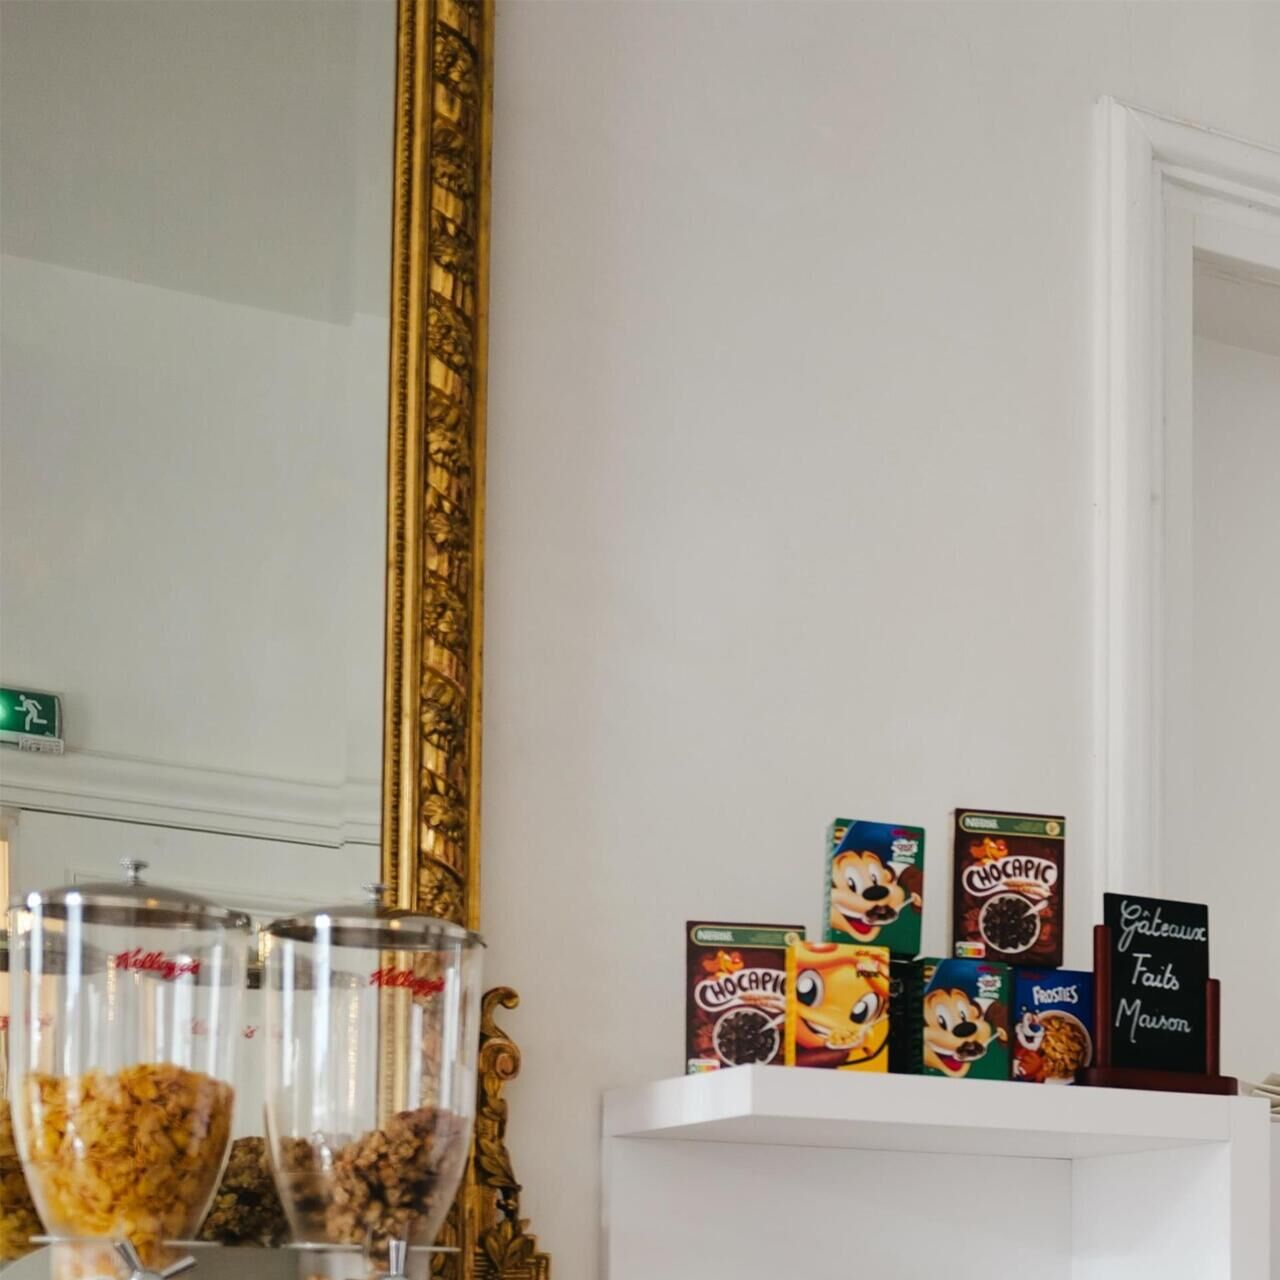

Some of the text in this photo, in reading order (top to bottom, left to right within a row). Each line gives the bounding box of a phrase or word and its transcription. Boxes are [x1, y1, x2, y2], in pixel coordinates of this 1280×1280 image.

[965, 857, 1053, 892] CHOCAPIC
[1117, 899, 1207, 953] Gâteaux
[1131, 952, 1181, 991] Faits
[1114, 997, 1192, 1044] Maison
